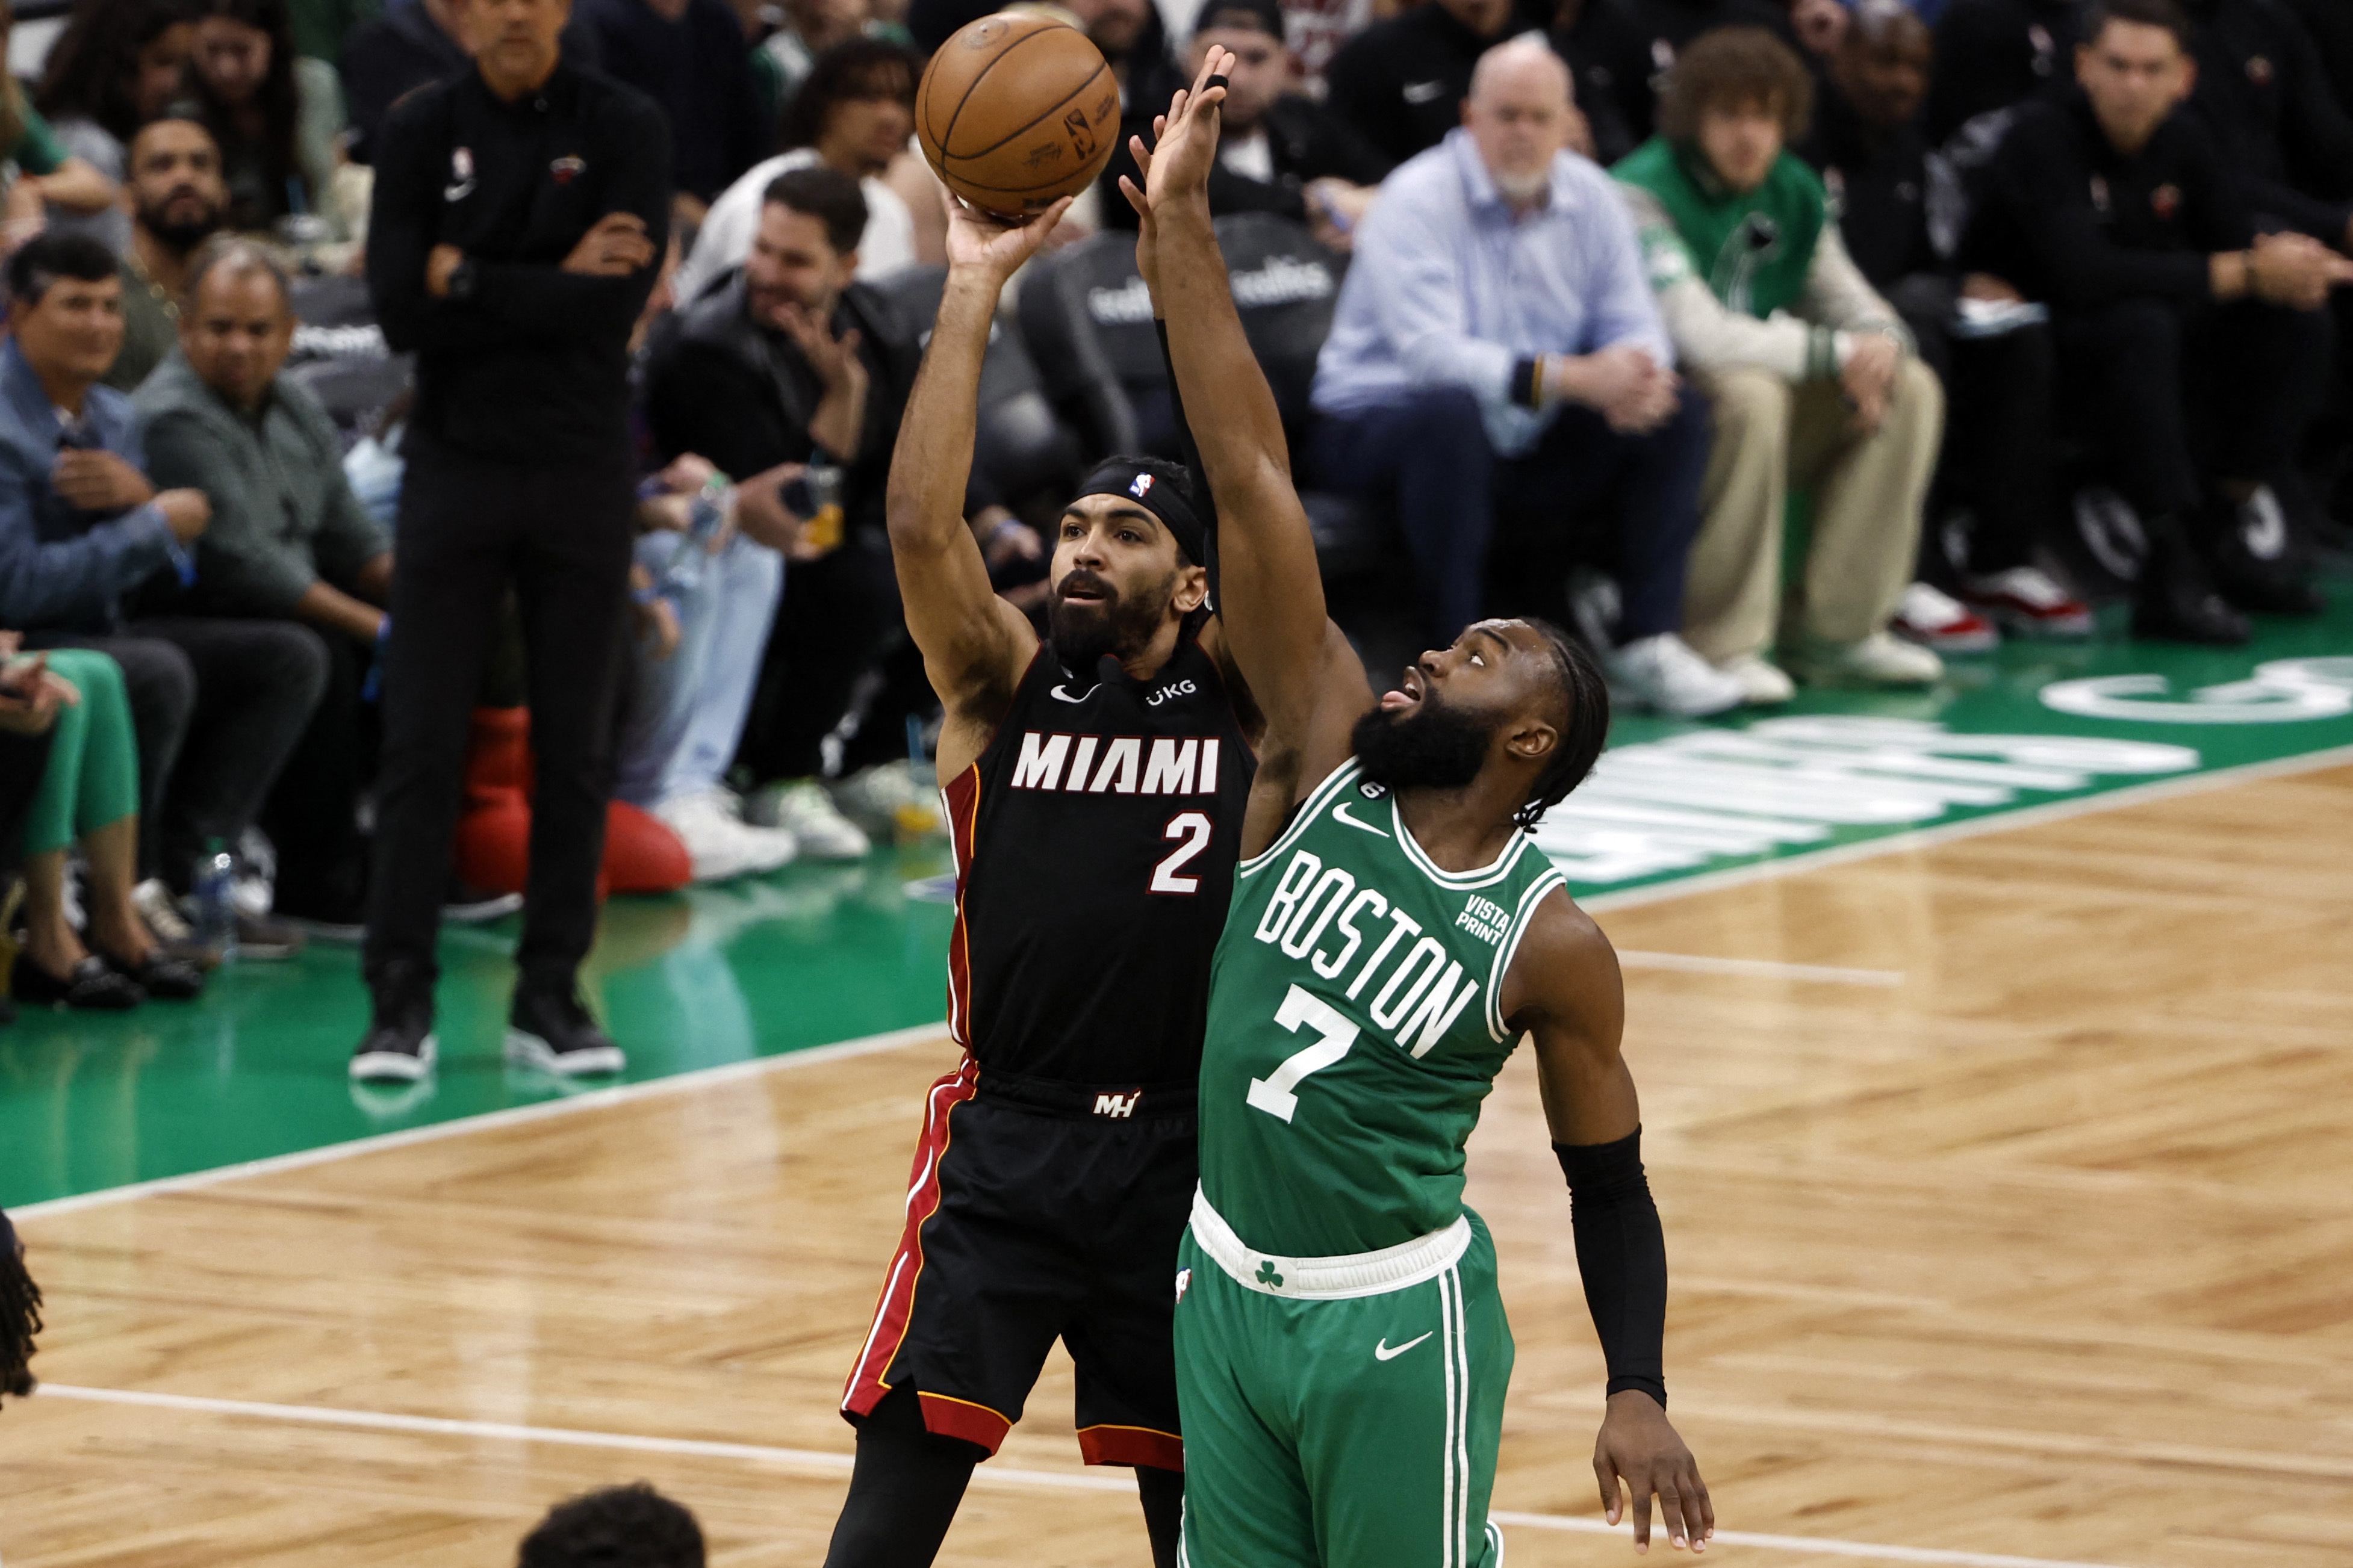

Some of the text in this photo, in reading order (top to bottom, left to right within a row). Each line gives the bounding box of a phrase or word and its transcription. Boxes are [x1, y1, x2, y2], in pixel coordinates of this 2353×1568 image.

[1010, 731, 1221, 796] MIAMI
[1360, 781, 1385, 798] 6
[1146, 810, 1214, 895] 2
[1455, 911, 1503, 946] PRINT
[1464, 894, 1510, 934] VISTA
[1254, 849, 1480, 1059] BOSTON
[1246, 982, 1361, 1124] 7
